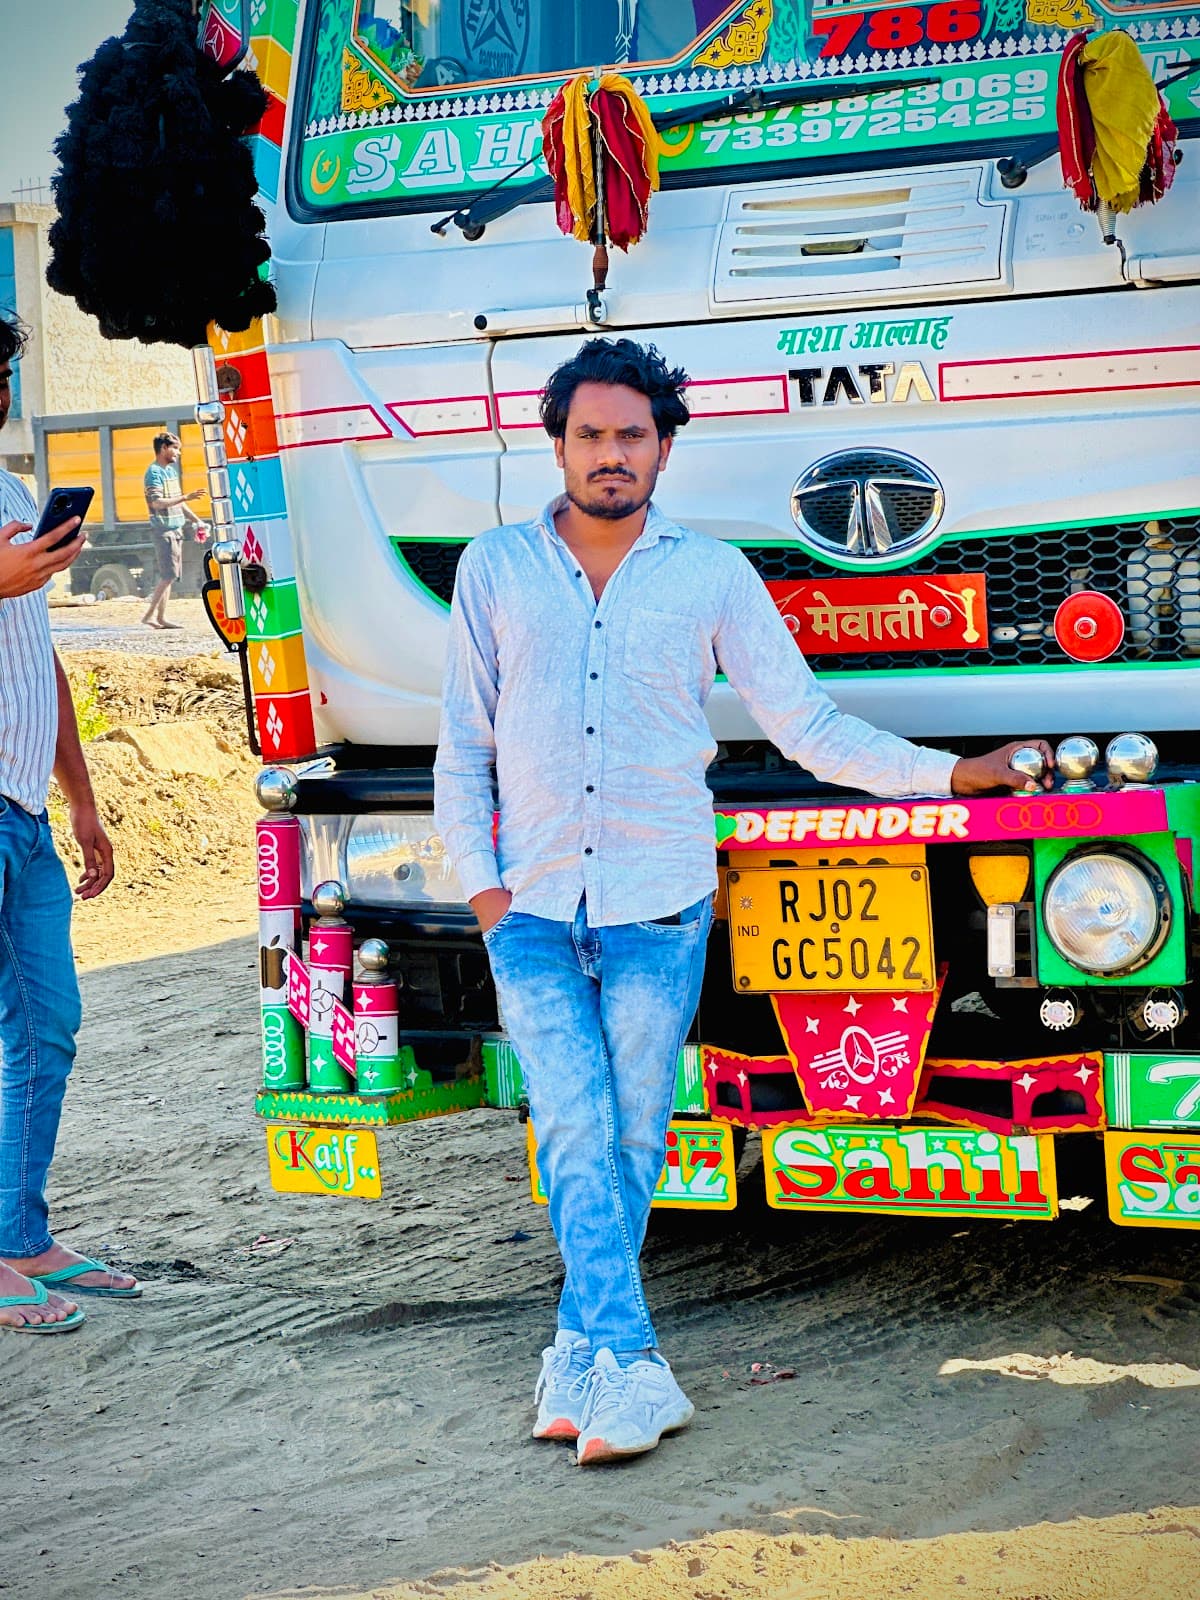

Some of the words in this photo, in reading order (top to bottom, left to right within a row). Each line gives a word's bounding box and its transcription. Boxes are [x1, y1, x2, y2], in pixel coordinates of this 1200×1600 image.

[812, 1, 982, 58] 786
[700, 95, 1047, 154] 7339725425
[776, 324, 849, 356] माशा
[788, 360, 936, 407] TATA
[803, 588, 929, 643] मेवाती
[734, 803, 971, 843] DEFENDER
[778, 878, 880, 924] RJ02
[737, 925, 760, 937] IND
[772, 936, 923, 980] GC5042
[773, 1128, 1044, 1202] Sahil
